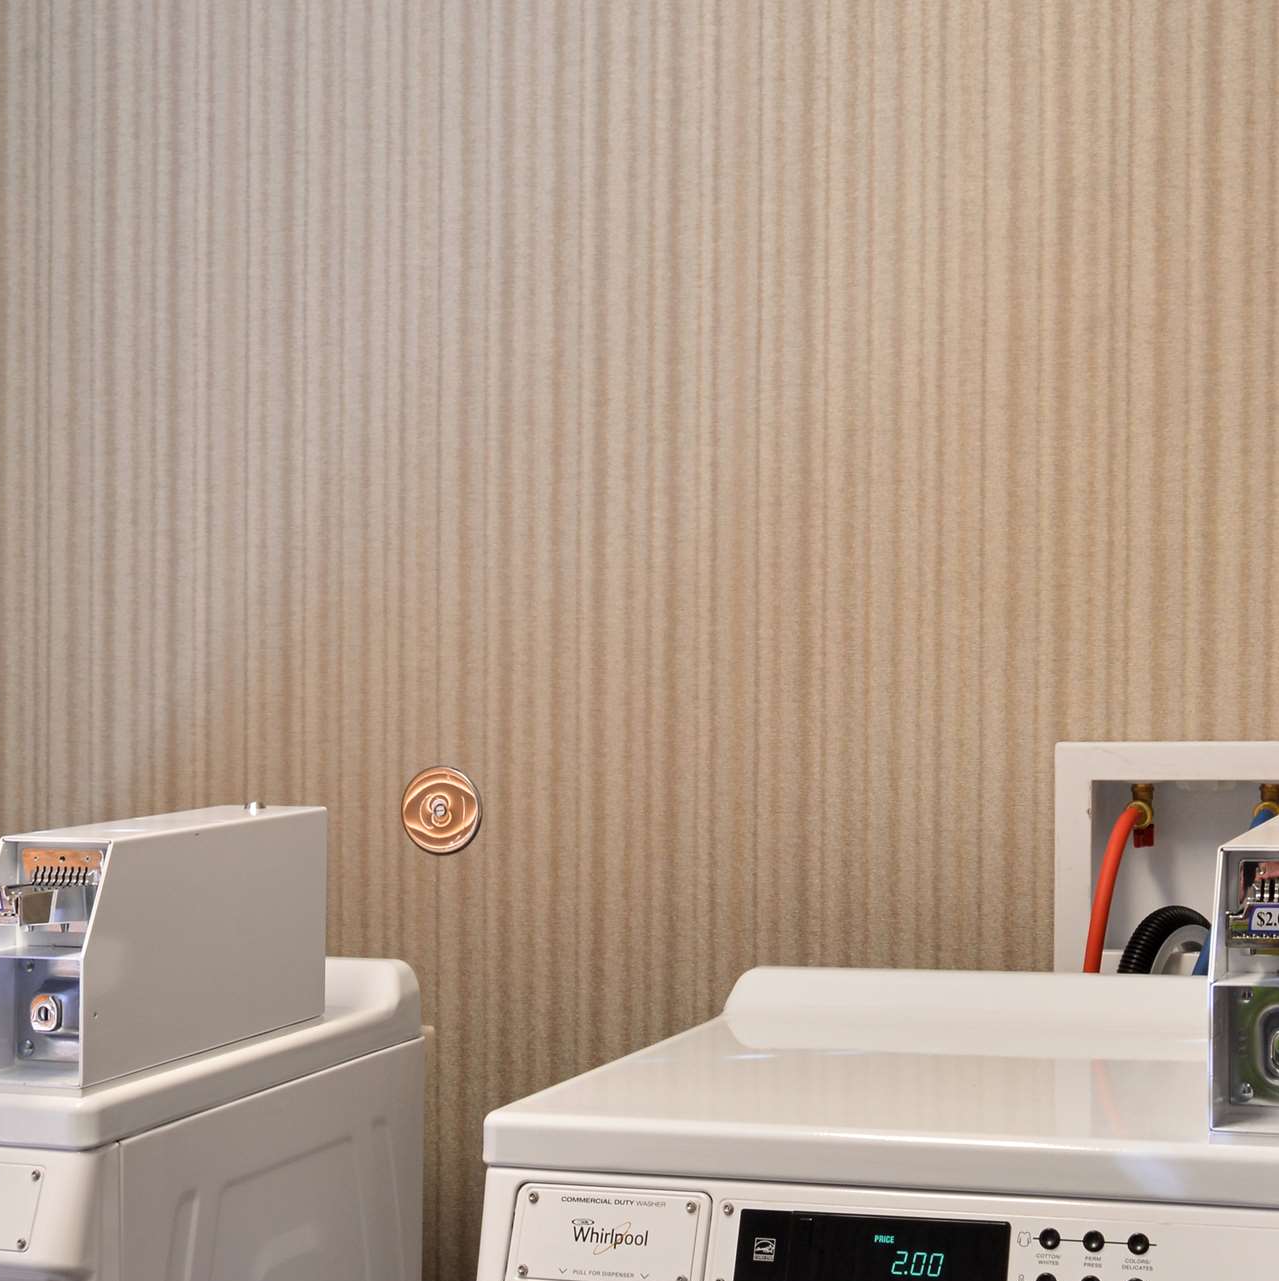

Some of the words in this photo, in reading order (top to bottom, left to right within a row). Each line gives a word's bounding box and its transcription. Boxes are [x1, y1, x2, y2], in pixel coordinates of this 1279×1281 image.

[561, 1195, 612, 1206] COMMERCIAL
[635, 1200, 666, 1208] WASHER
[573, 1225, 649, 1249] Whirlpool
[874, 1234, 895, 1244] PRICE
[891, 1250, 944, 1278] 2.00
